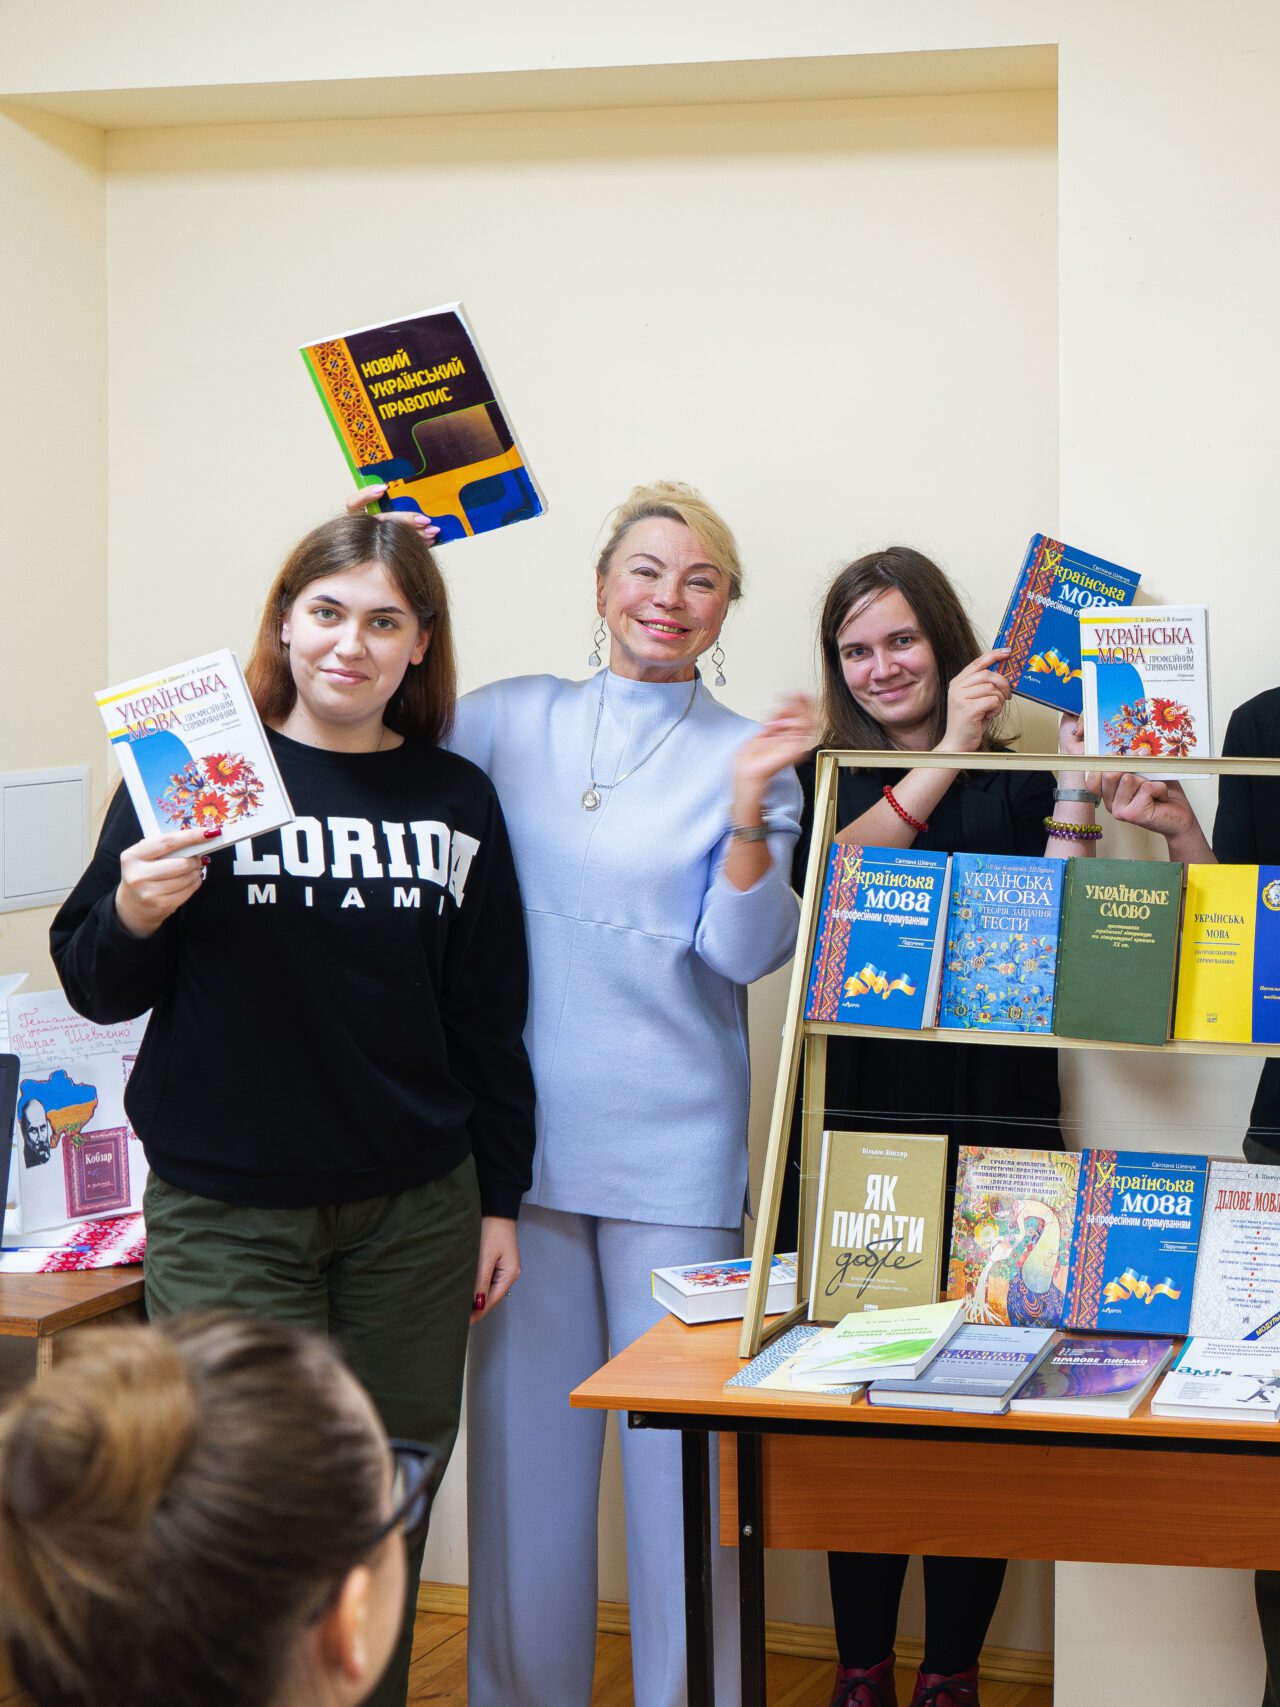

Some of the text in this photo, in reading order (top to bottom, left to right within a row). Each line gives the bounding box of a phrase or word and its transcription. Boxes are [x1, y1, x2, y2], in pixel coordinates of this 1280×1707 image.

[360, 348, 412, 379] НОВИЙ
[368, 356, 466, 400] УКРАЇНСЬКИЙ
[377, 386, 453, 420] ПРАВОПИС
[1040, 548, 1126, 602] Українська
[1094, 624, 1194, 646] УКРАЇНСЬКА
[1097, 646, 1147, 665] МОВА
[1149, 653, 1194, 663] ПРОФЕСІЙНИМ
[1144, 663, 1195, 672] СПРЯМУВАННЯМ
[116, 673, 227, 724] УКРАЇНСЬКА
[182, 708, 238, 732] СПРЯМУВАННЯМ
[184, 699, 235, 722] ПРОФЕСІЙНИМ
[126, 710, 182, 743] МОВА
[840, 857, 935, 891] Українська
[963, 870, 1054, 891] УКРАЇНСЬКА
[982, 887, 1053, 906] МОВА
[1084, 884, 1170, 906] УКРАЇНСЬКЕ
[841, 909, 883, 923] професійним
[883, 912, 930, 927] спрямуванням
[1099, 902, 1151, 920] СЛОВО
[1194, 913, 1245, 925] УКРАЇНСЬКА
[981, 915, 1030, 932] ТЕСТИ
[1205, 929, 1230, 939] МОВА
[12, 1033, 57, 1055] Тарас
[64, 1027, 130, 1045] Шевченко
[85, 1151, 113, 1165] Кобзар
[1094, 1162, 1195, 1195] Українська
[864, 1173, 899, 1212] ЯК
[1214, 1189, 1253, 1213] ДІЛОВЕ
[831, 1210, 925, 1254] ПИСАТИ
[1095, 1213, 1141, 1228] професійним
[1141, 1217, 1191, 1231] спрямуванням
[1052, 1356, 1101, 1364] ПРАВОВЕ
[1103, 1357, 1148, 1365] ПИСЬМО
